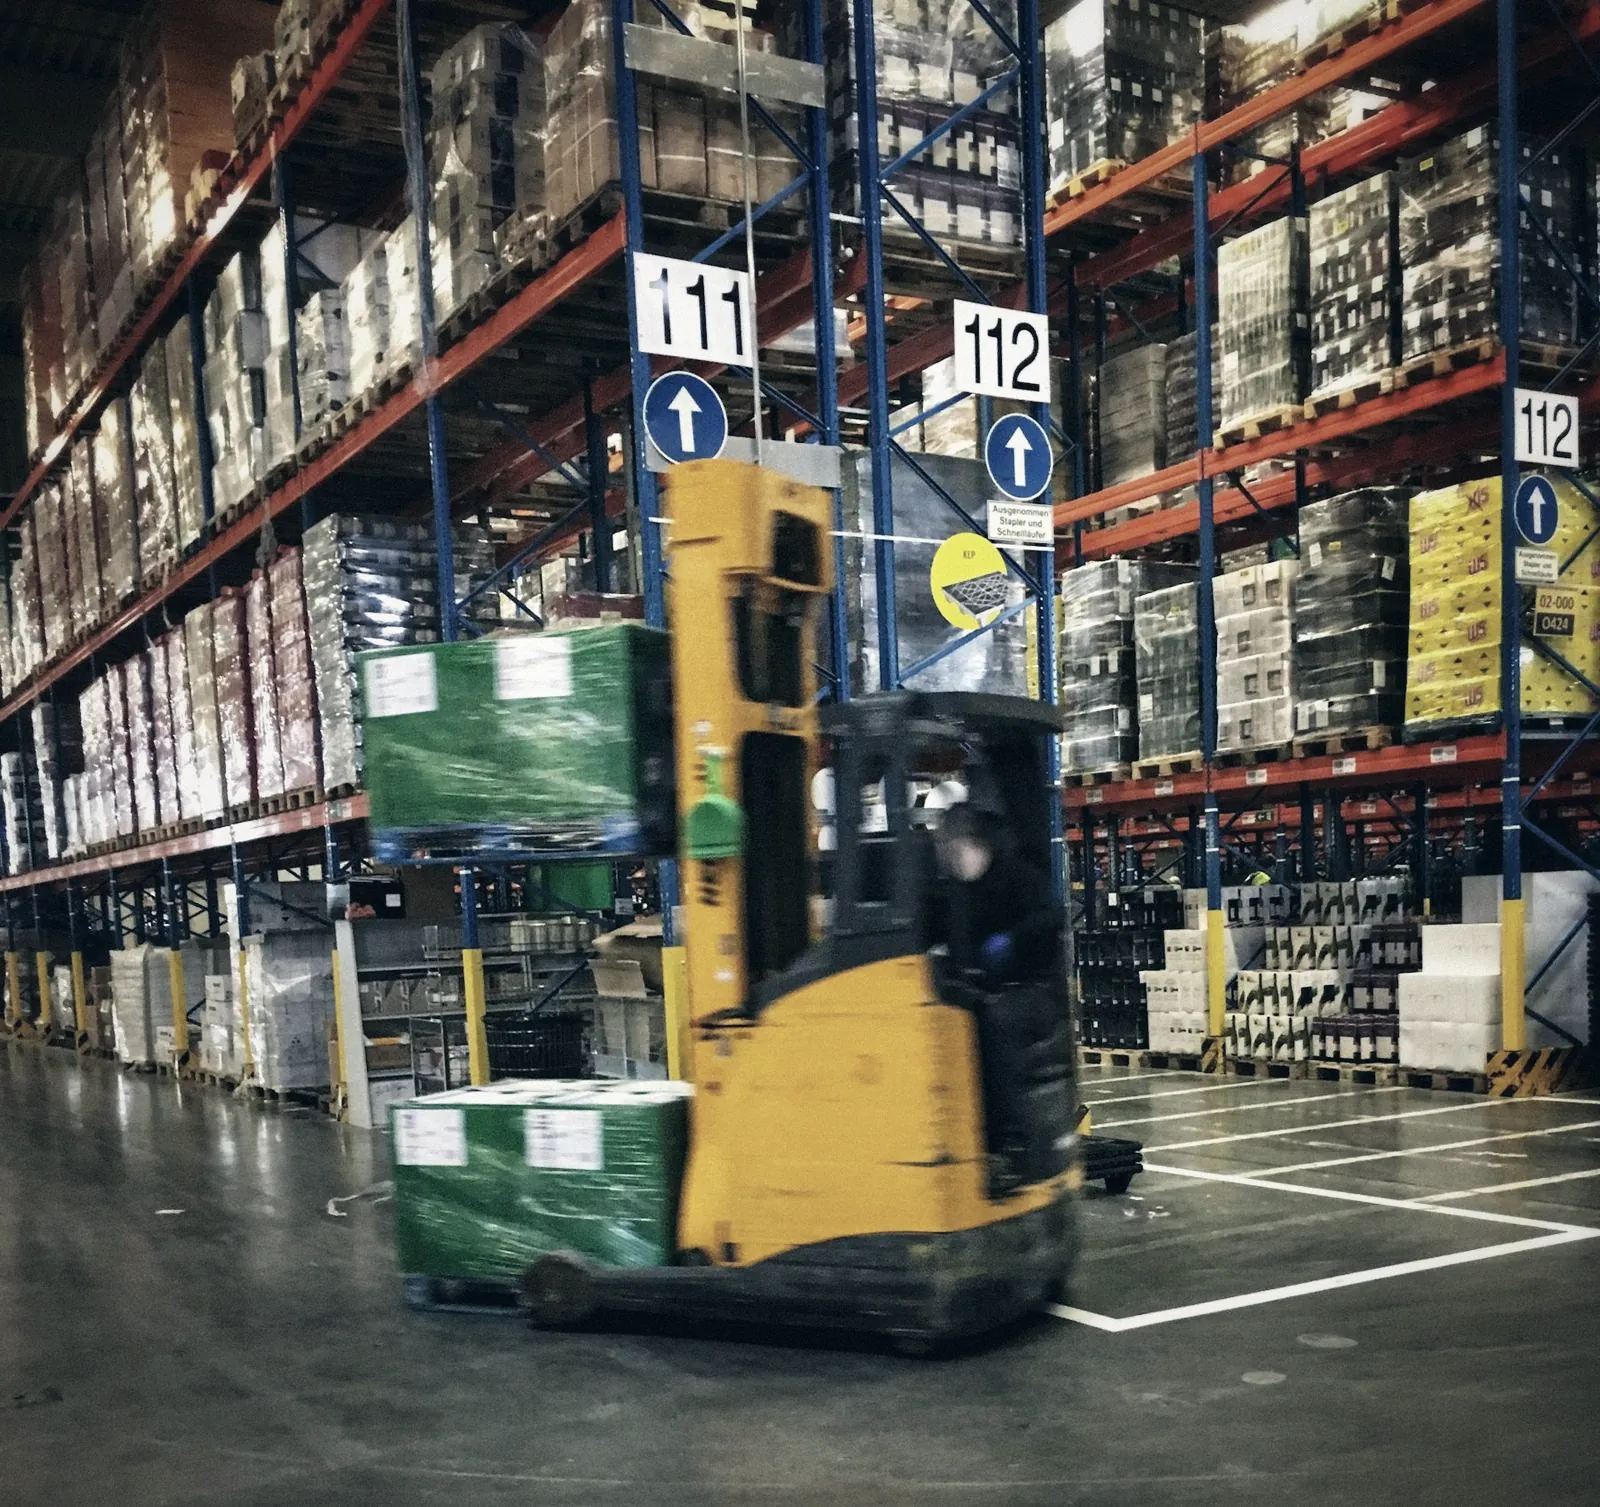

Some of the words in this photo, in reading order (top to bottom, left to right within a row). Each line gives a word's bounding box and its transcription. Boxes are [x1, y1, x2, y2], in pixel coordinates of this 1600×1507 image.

[649, 267, 744, 356] 111
[965, 314, 1040, 393] 112
[1521, 398, 1573, 460] 112
[992, 504, 1049, 517] Ausgenommen
[999, 516, 1026, 526] Stapler
[1027, 519, 1043, 528] und
[963, 550, 976, 559] KEP
[1539, 594, 1575, 610] 02-000
